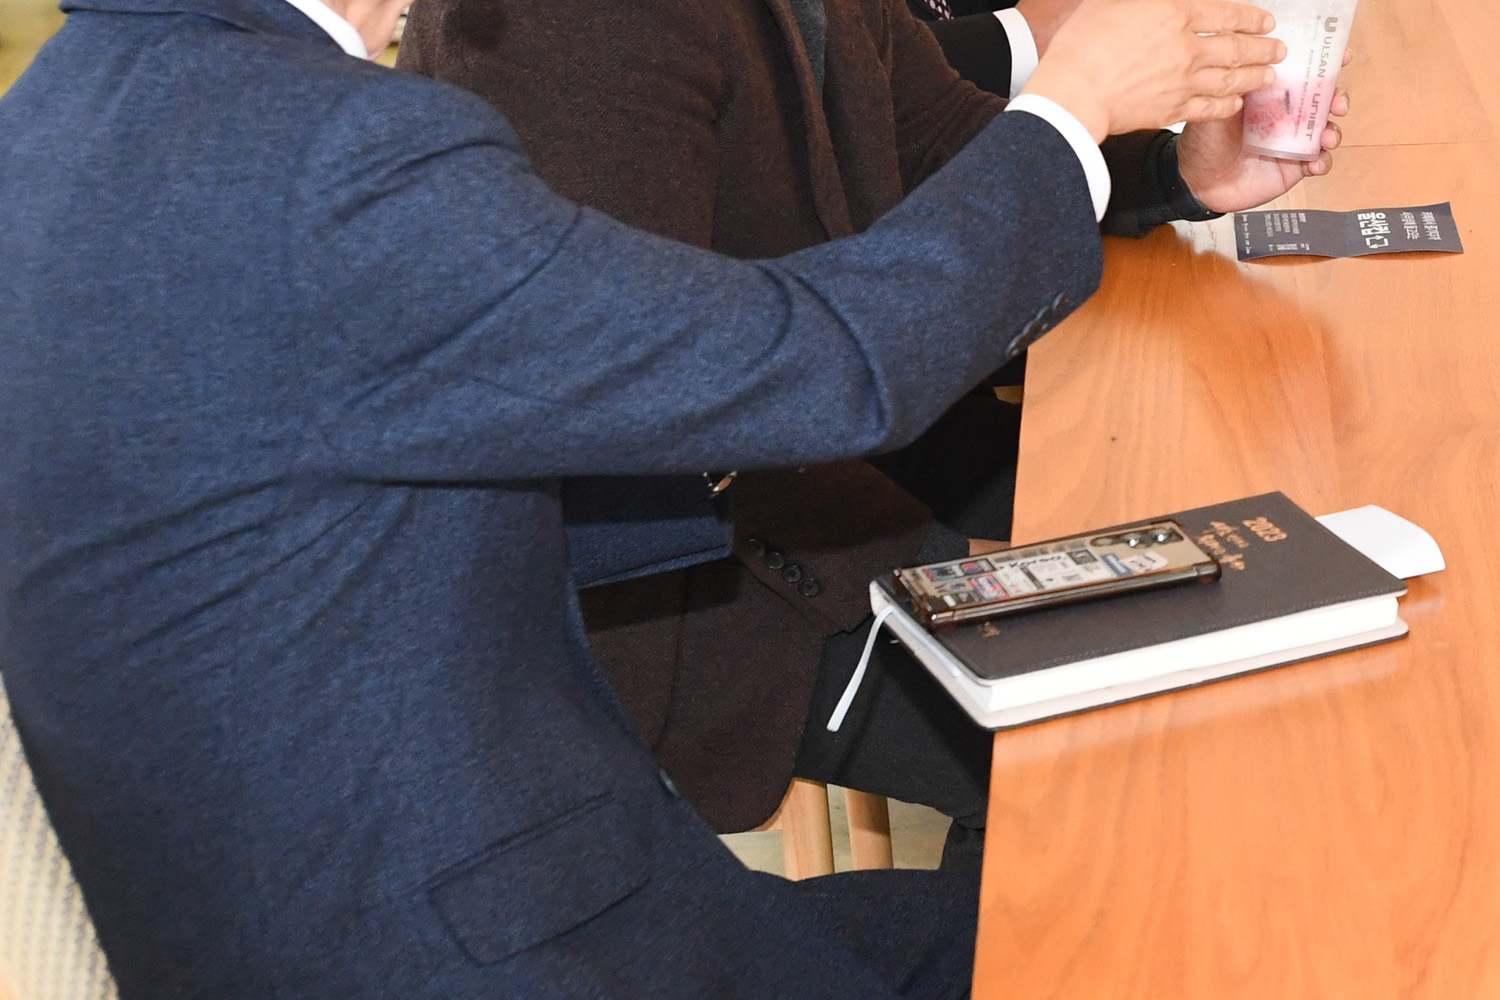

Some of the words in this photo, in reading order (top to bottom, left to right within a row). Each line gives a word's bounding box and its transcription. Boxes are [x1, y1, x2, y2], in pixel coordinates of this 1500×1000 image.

[1317, 36, 1333, 78] ULSAN
[1357, 212, 1391, 236] 울산컵
[1242, 517, 1288, 542] 2023
